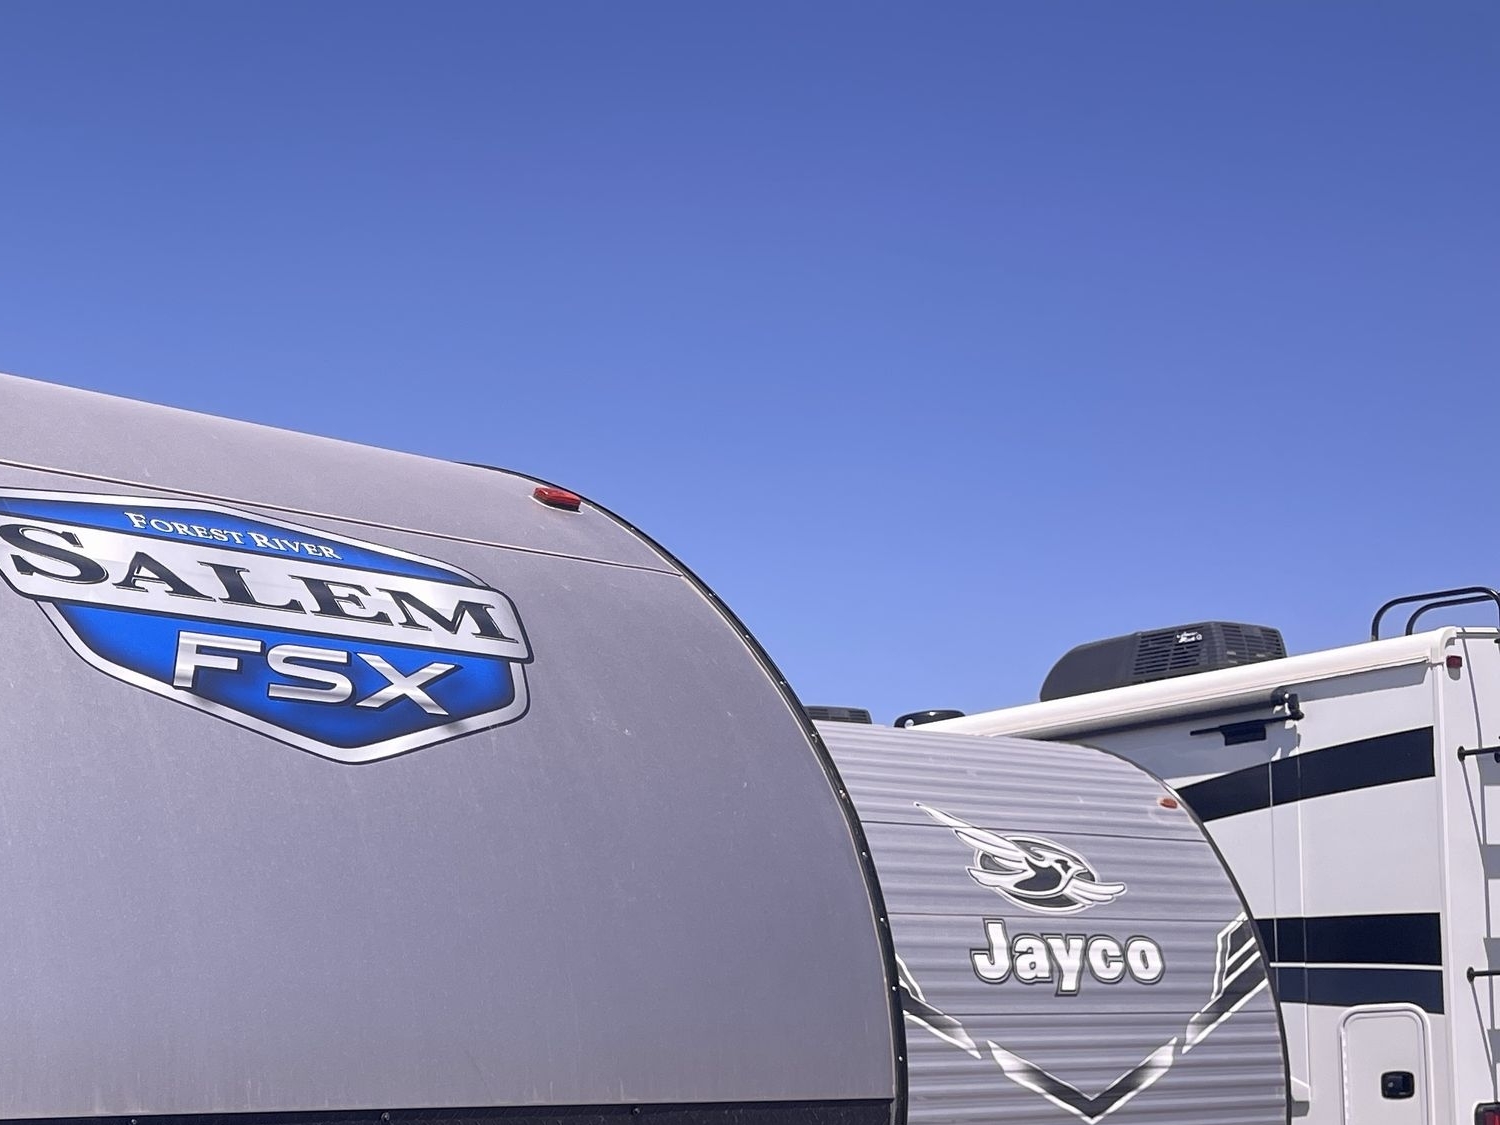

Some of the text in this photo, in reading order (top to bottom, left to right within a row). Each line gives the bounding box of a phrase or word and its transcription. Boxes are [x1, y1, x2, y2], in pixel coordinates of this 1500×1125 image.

[124, 511, 344, 560] FOREST RIVER
[172, 630, 458, 717] FSX
[969, 917, 1166, 998] Jayco
